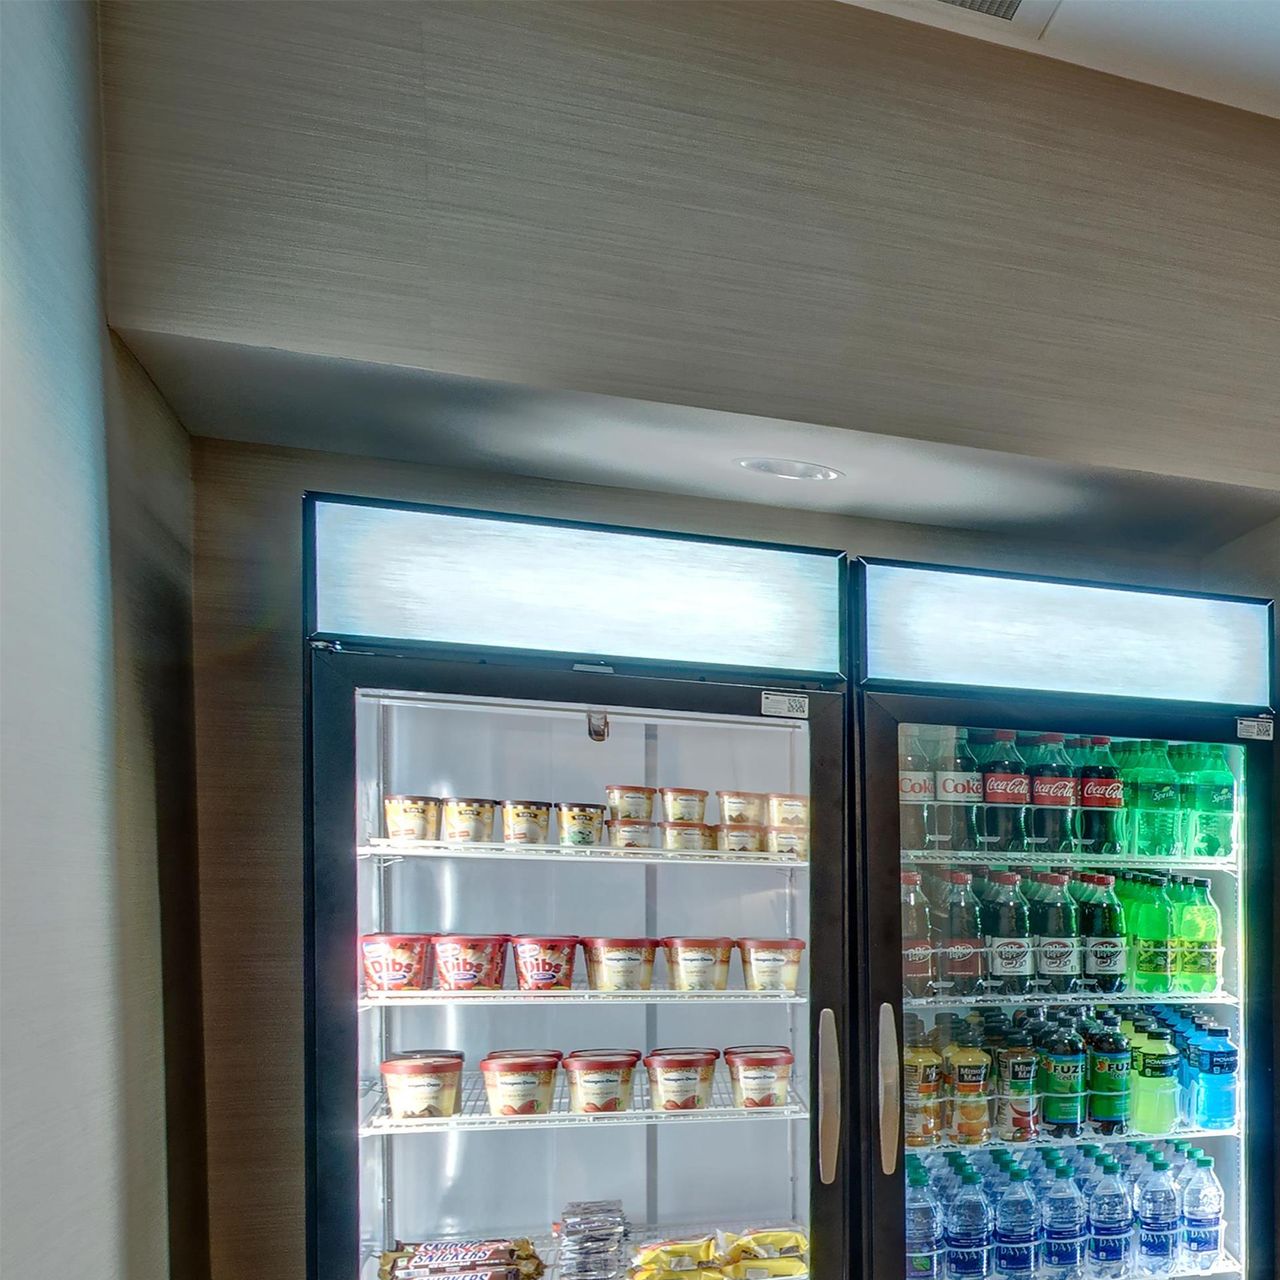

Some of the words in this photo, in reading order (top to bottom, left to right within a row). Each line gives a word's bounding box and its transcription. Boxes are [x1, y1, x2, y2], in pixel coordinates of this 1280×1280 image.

[942, 777, 982, 794] Coke
[1153, 789, 1175, 801] Sprite
[371, 958, 414, 973] Dibs
[444, 957, 483, 973] Dibs
[524, 958, 563, 973] Dibs
[1053, 1064, 1085, 1074] FUZE
[1108, 1063, 1130, 1072] FUZ
[413, 1251, 489, 1264] SNICKERS
